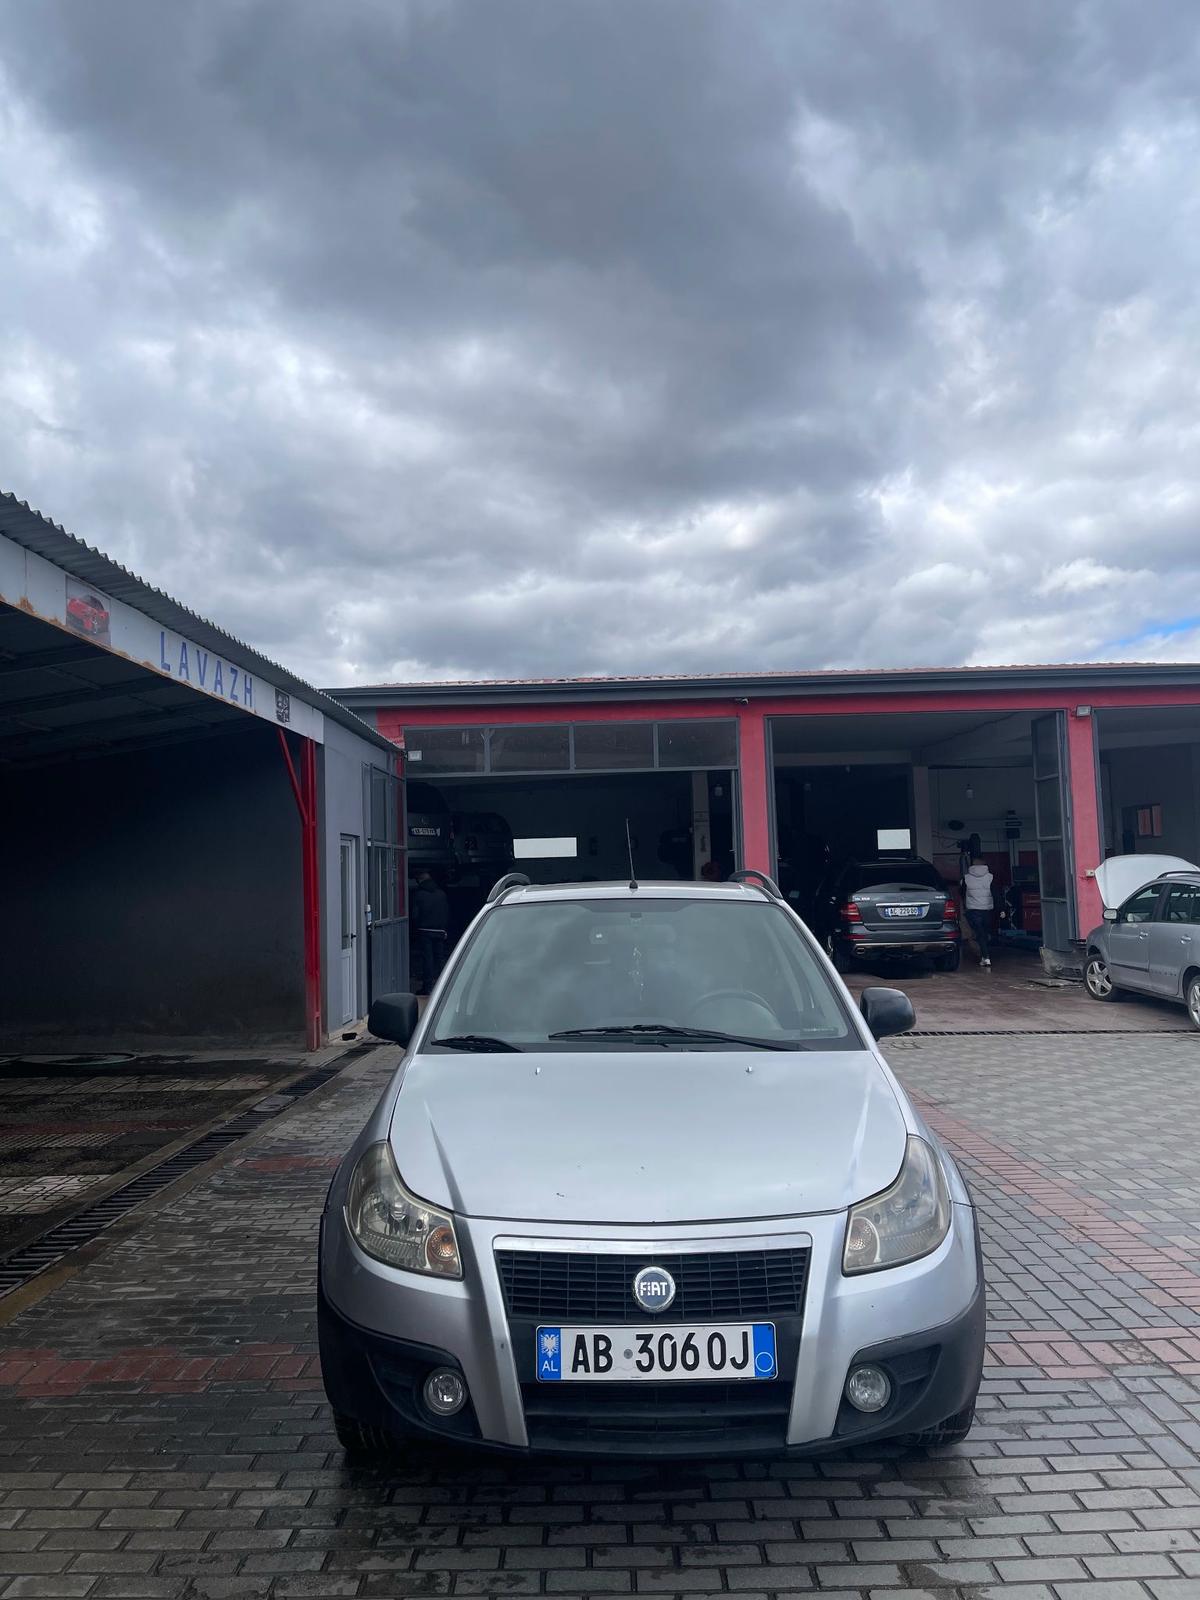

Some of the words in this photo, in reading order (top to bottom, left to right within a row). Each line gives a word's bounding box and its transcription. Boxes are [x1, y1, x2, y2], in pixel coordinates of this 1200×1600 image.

[159, 631, 254, 708] LAVAZH
[639, 1281, 668, 1297] FIAT
[542, 1361, 558, 1372] AL
[571, 1333, 614, 1373] AB
